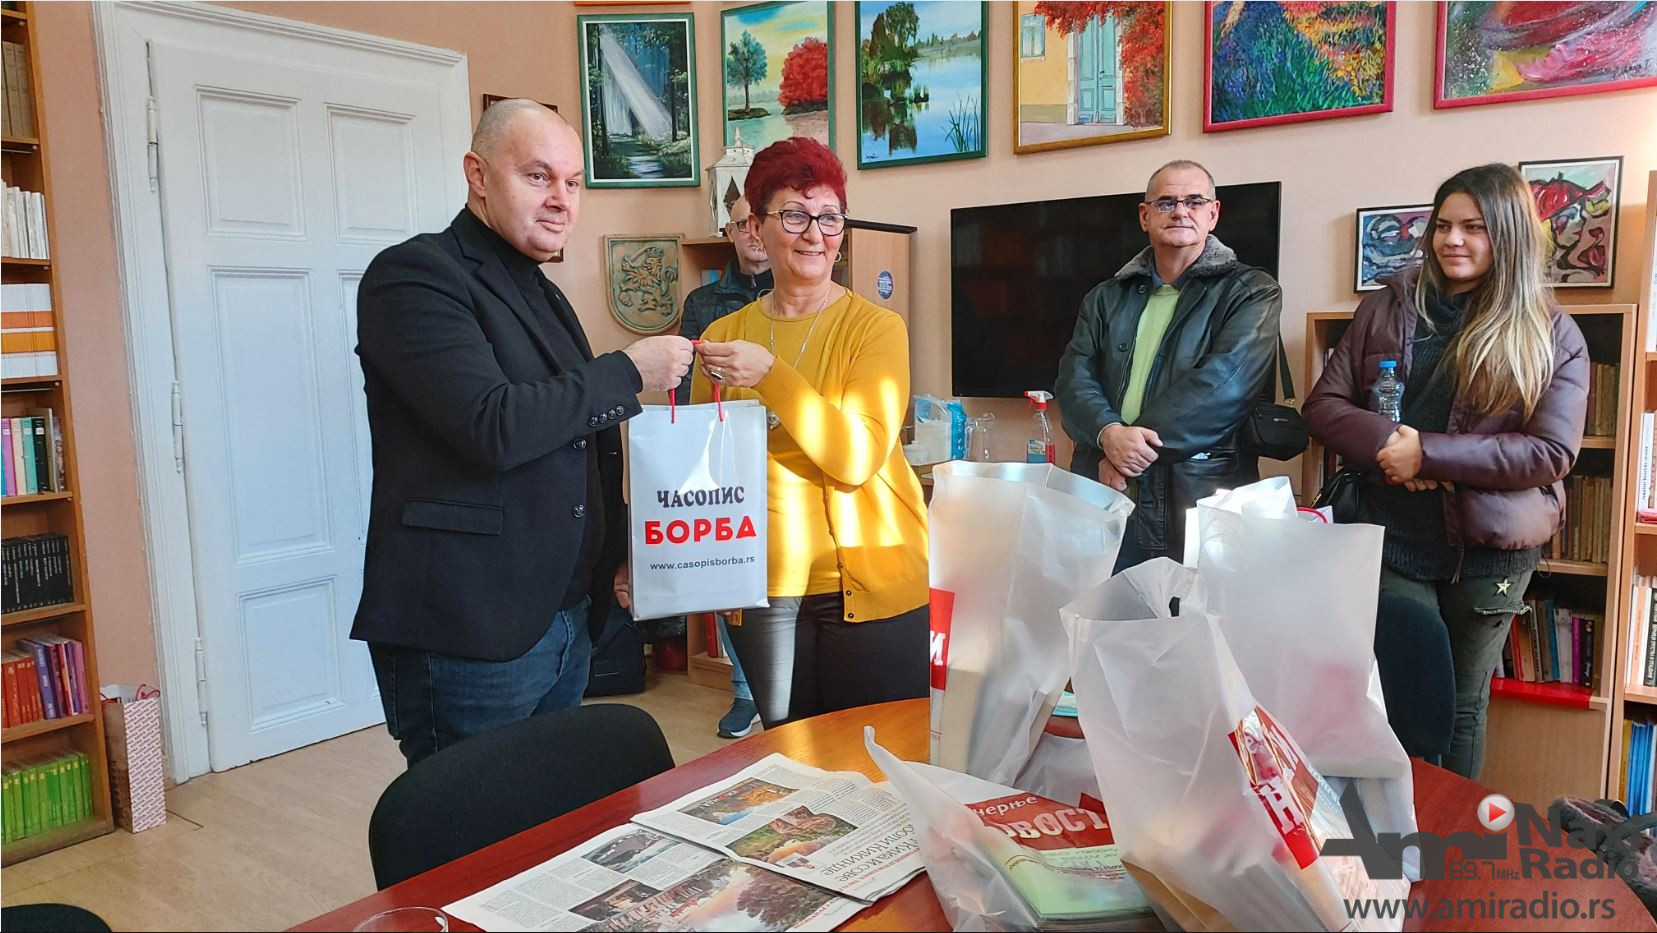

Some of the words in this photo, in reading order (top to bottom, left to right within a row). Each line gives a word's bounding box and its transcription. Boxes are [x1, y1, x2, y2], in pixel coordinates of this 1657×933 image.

[657, 486, 745, 508] ЧАСОПИС
[645, 515, 757, 545] БОРБА
[650, 556, 755, 570] www.casopisborba.rs
[973, 796, 1037, 816] черње
